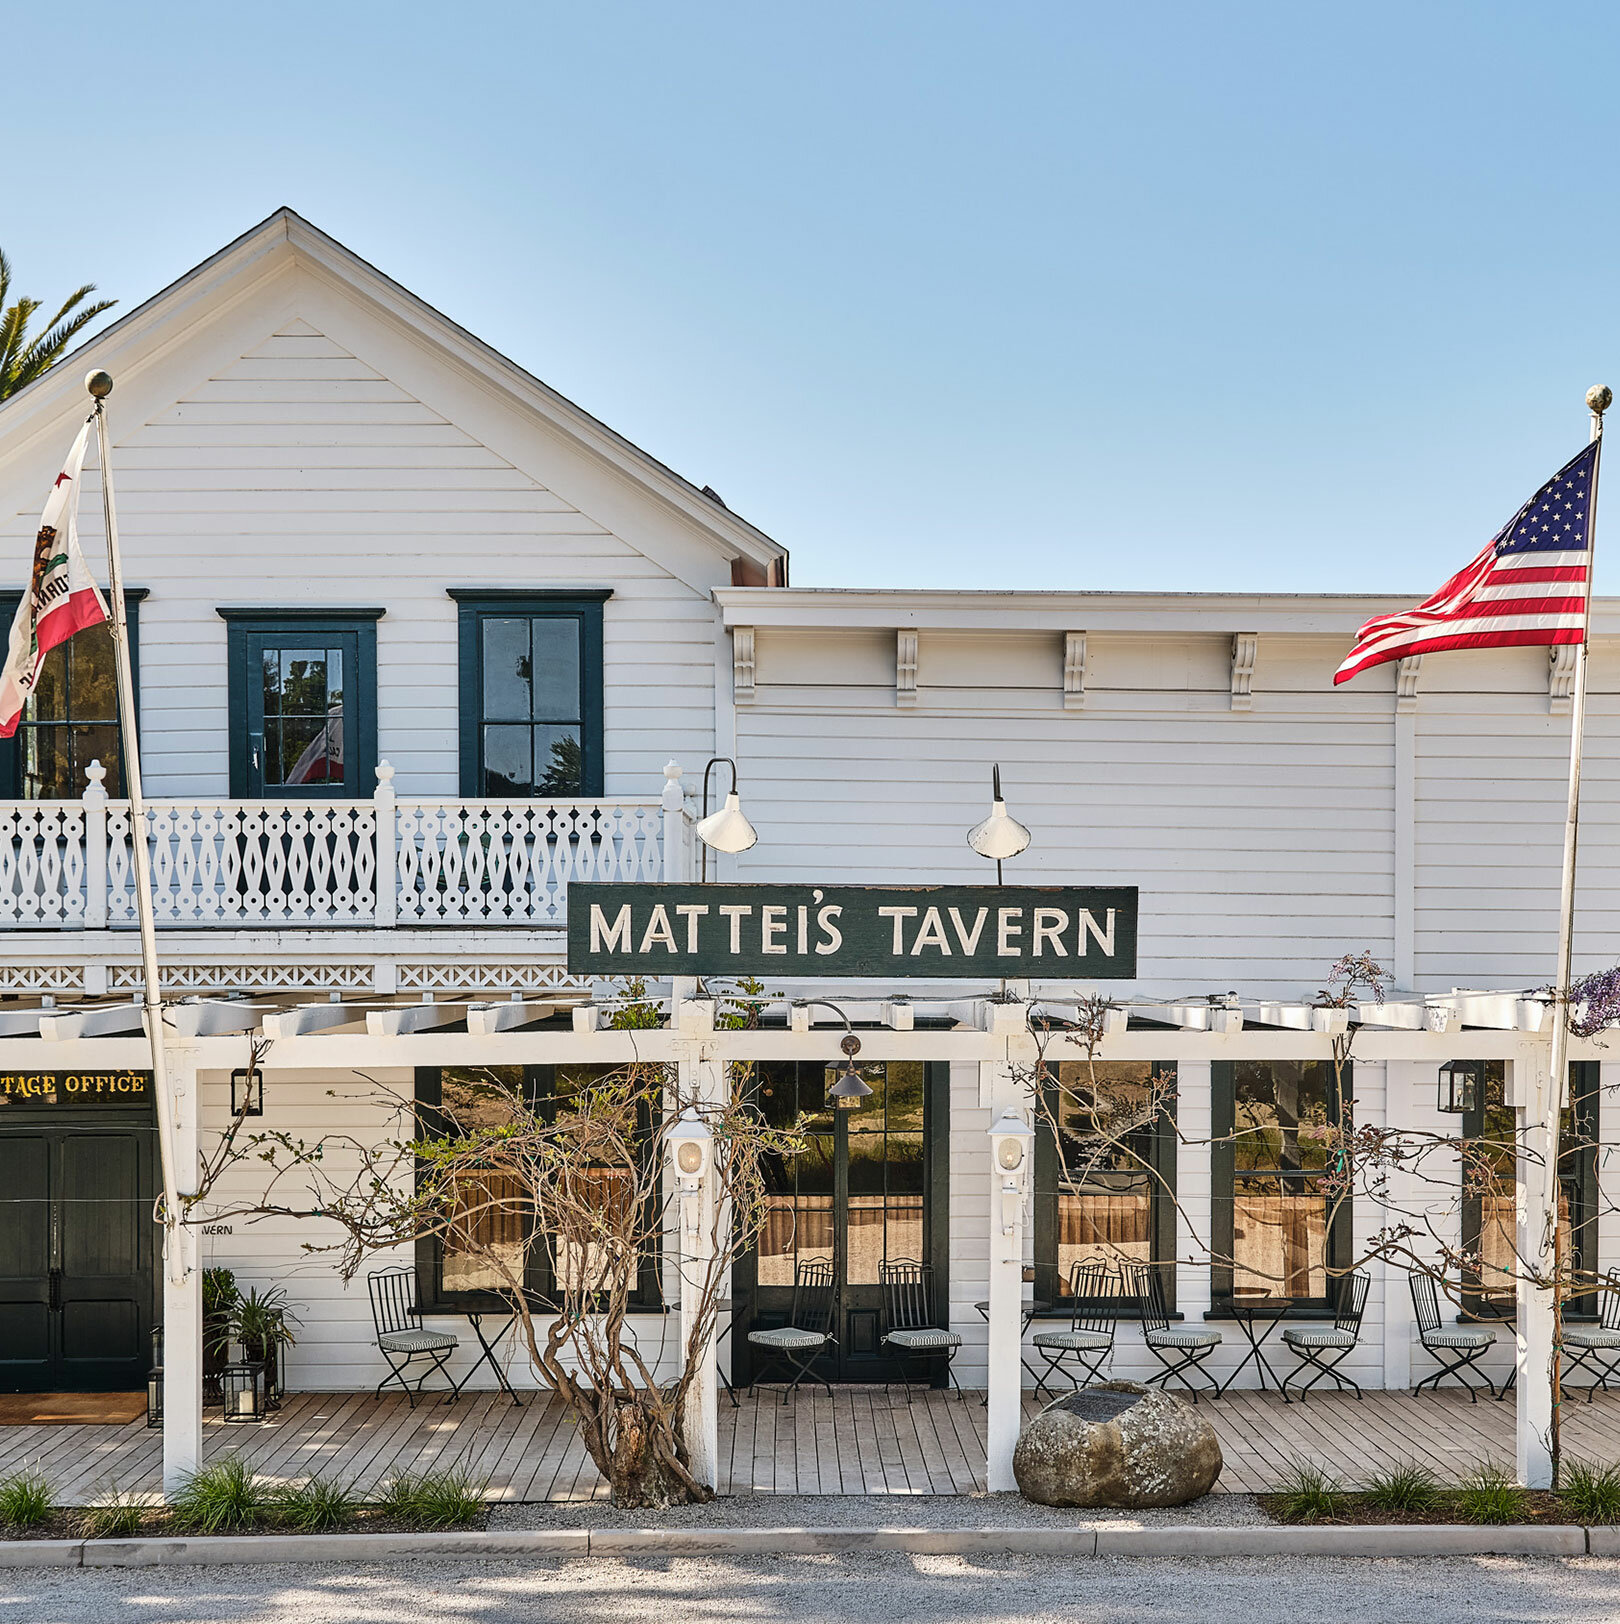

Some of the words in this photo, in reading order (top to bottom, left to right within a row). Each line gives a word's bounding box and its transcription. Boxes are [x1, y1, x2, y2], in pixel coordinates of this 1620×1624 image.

[589, 889, 844, 956] MATTEI'S
[877, 905, 1116, 957] TAVERN
[0, 1075, 56, 1098] TAGE
[64, 1075, 144, 1092] OFFICE
